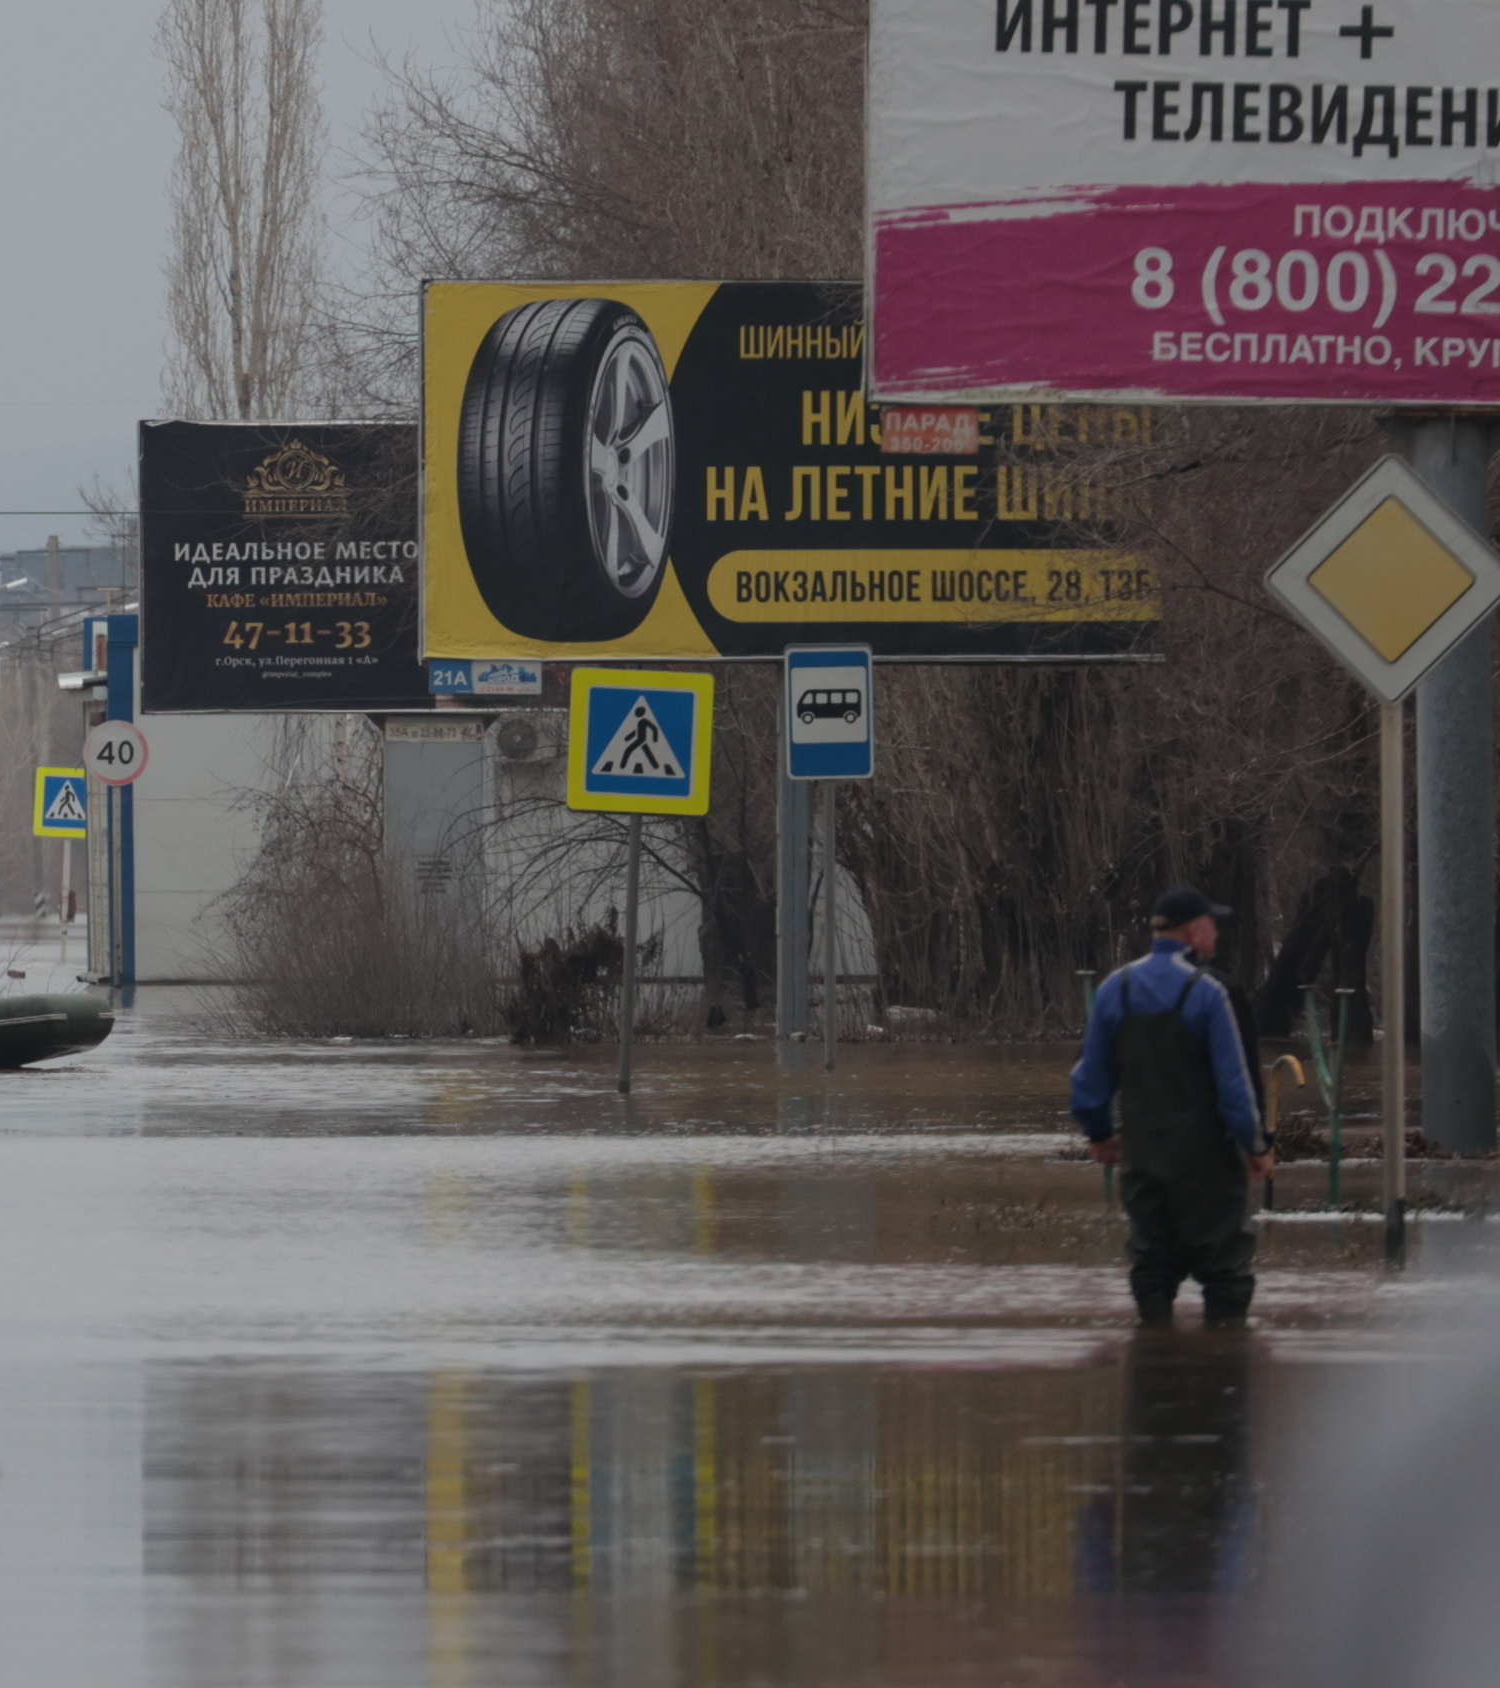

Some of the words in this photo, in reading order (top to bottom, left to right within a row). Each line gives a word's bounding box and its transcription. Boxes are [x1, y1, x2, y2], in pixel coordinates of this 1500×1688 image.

[995, 0, 1310, 57] ИНТЕРНЕТ
[1131, 246, 1174, 309] 8
[1202, 245, 1398, 328] (800)
[739, 319, 867, 359] ШИННЫЙ
[1152, 331, 1402, 370] БЕСПЛАТНО,
[885, 411, 972, 437] ПАРАД
[244, 499, 348, 513] ИМПЕРИАЛ
[706, 465, 769, 522] НА
[785, 465, 978, 522] ЛЕТНИЕ
[173, 541, 326, 564] ИДЕАЛЬНОЕ
[335, 540, 418, 561] МЕСТО
[188, 566, 240, 588] ДЛЯ
[250, 565, 405, 588] ПРАЗДНИКА
[735, 569, 921, 604] ВОКЗАЛЬНОЕ
[206, 593, 256, 608] КАФЕ
[259, 592, 388, 608] «ИМПЕРИАЛ»
[223, 620, 373, 650] 47-11-33
[433, 670, 468, 686] 21А
[96, 740, 135, 765] 40
